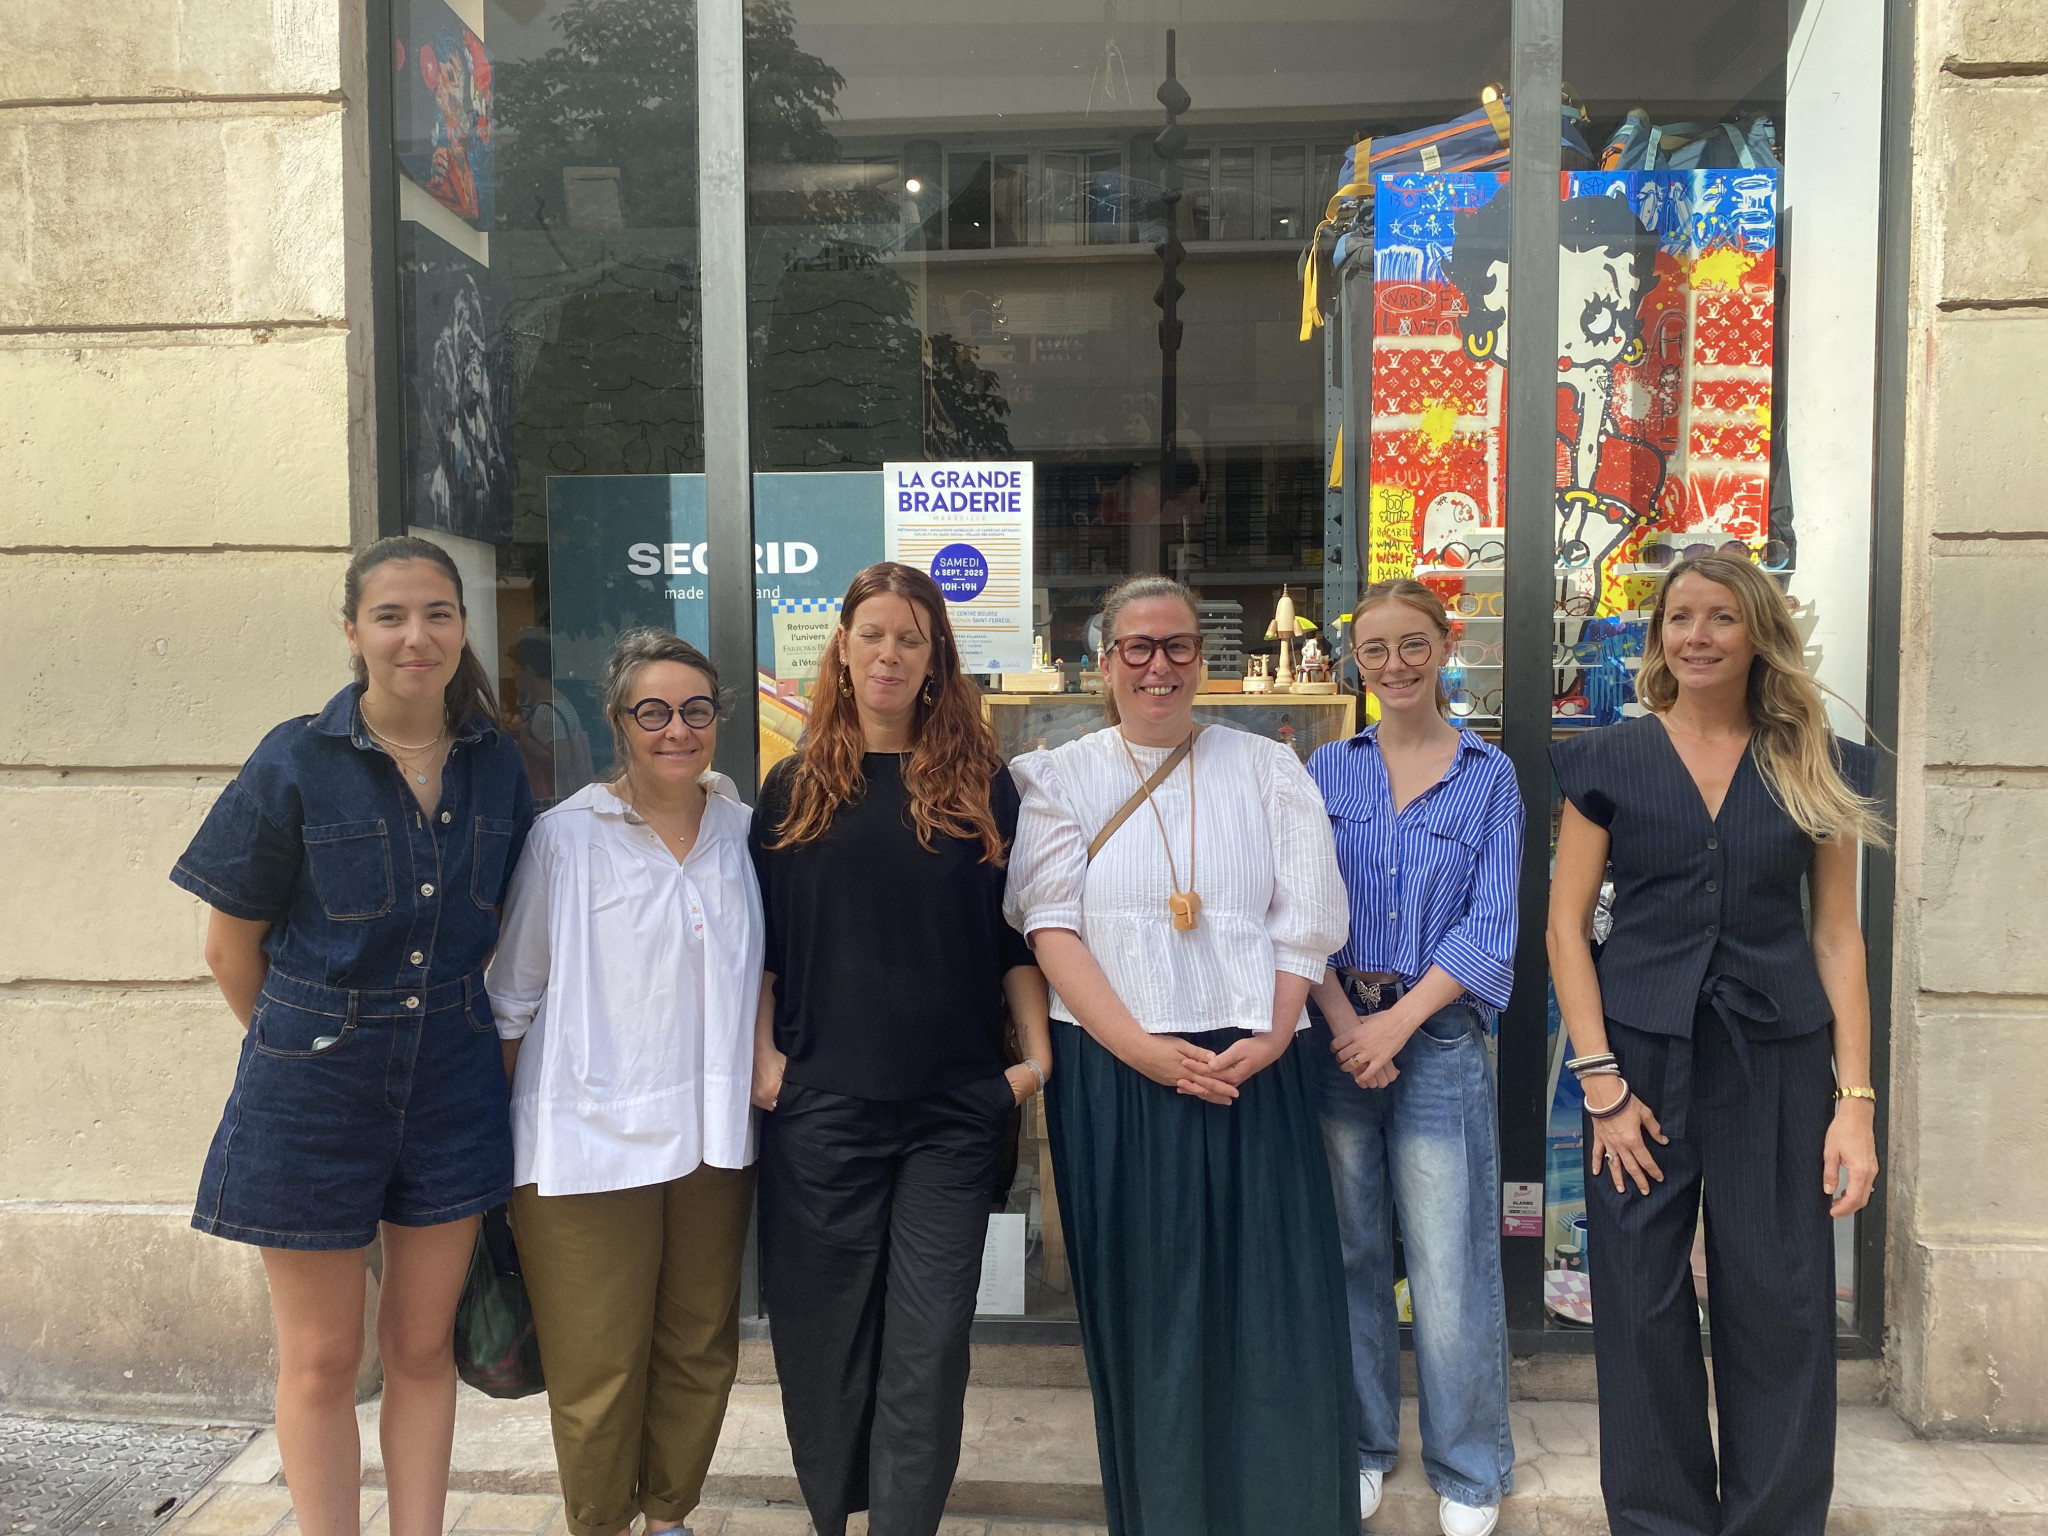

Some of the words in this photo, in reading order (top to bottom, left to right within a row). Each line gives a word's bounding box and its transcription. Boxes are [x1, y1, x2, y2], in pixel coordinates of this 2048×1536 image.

[898, 471, 925, 488] LA
[930, 470, 1021, 489] GRANDE
[898, 491, 1021, 512] BRADERIE
[627, 541, 819, 576] SEID
[939, 557, 979, 567] SAMEDI
[1376, 551, 1403, 564] WISH
[941, 569, 962, 577] SEPT.
[941, 582, 977, 591] 10H-19H
[664, 586, 704, 600] made
[956, 611, 976, 619] CENTRE
[977, 611, 998, 619] BOURSE
[787, 623, 829, 631] Retrouvez
[791, 633, 826, 641] l'univers
